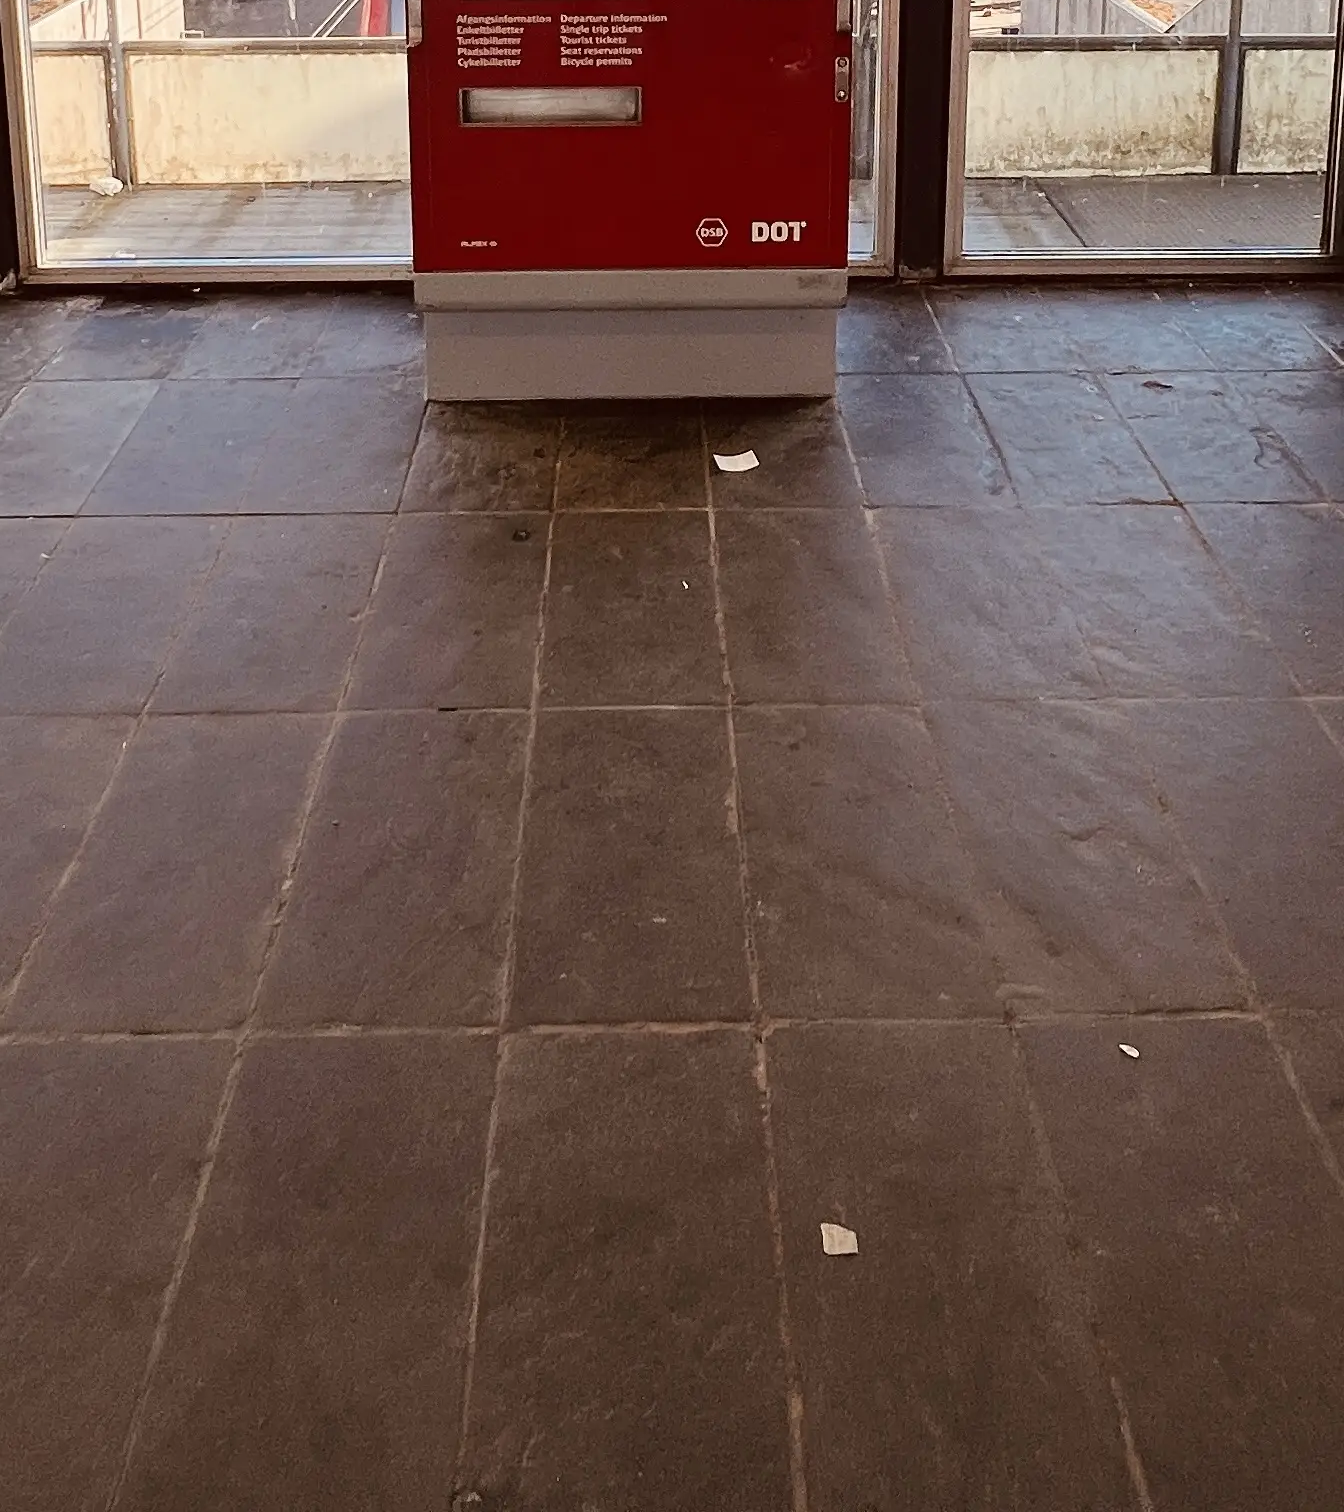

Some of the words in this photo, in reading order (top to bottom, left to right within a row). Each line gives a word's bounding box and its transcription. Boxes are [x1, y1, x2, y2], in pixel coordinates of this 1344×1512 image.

[455, 13, 552, 25] Afgangsinformation
[560, 13, 609, 25] Departure
[560, 24, 590, 35] Single
[591, 24, 610, 35] trip
[611, 24, 643, 34] tickets
[560, 35, 593, 45] Tourist
[594, 34, 628, 45] tickets
[560, 46, 583, 55] Seat
[583, 46, 643, 56] reservations
[457, 57, 522, 69] Cykelbilletter
[560, 57, 594, 68] Bicycle
[595, 57, 633, 68] permits
[699, 226, 724, 238] DSB
[751, 220, 803, 243] DOT
